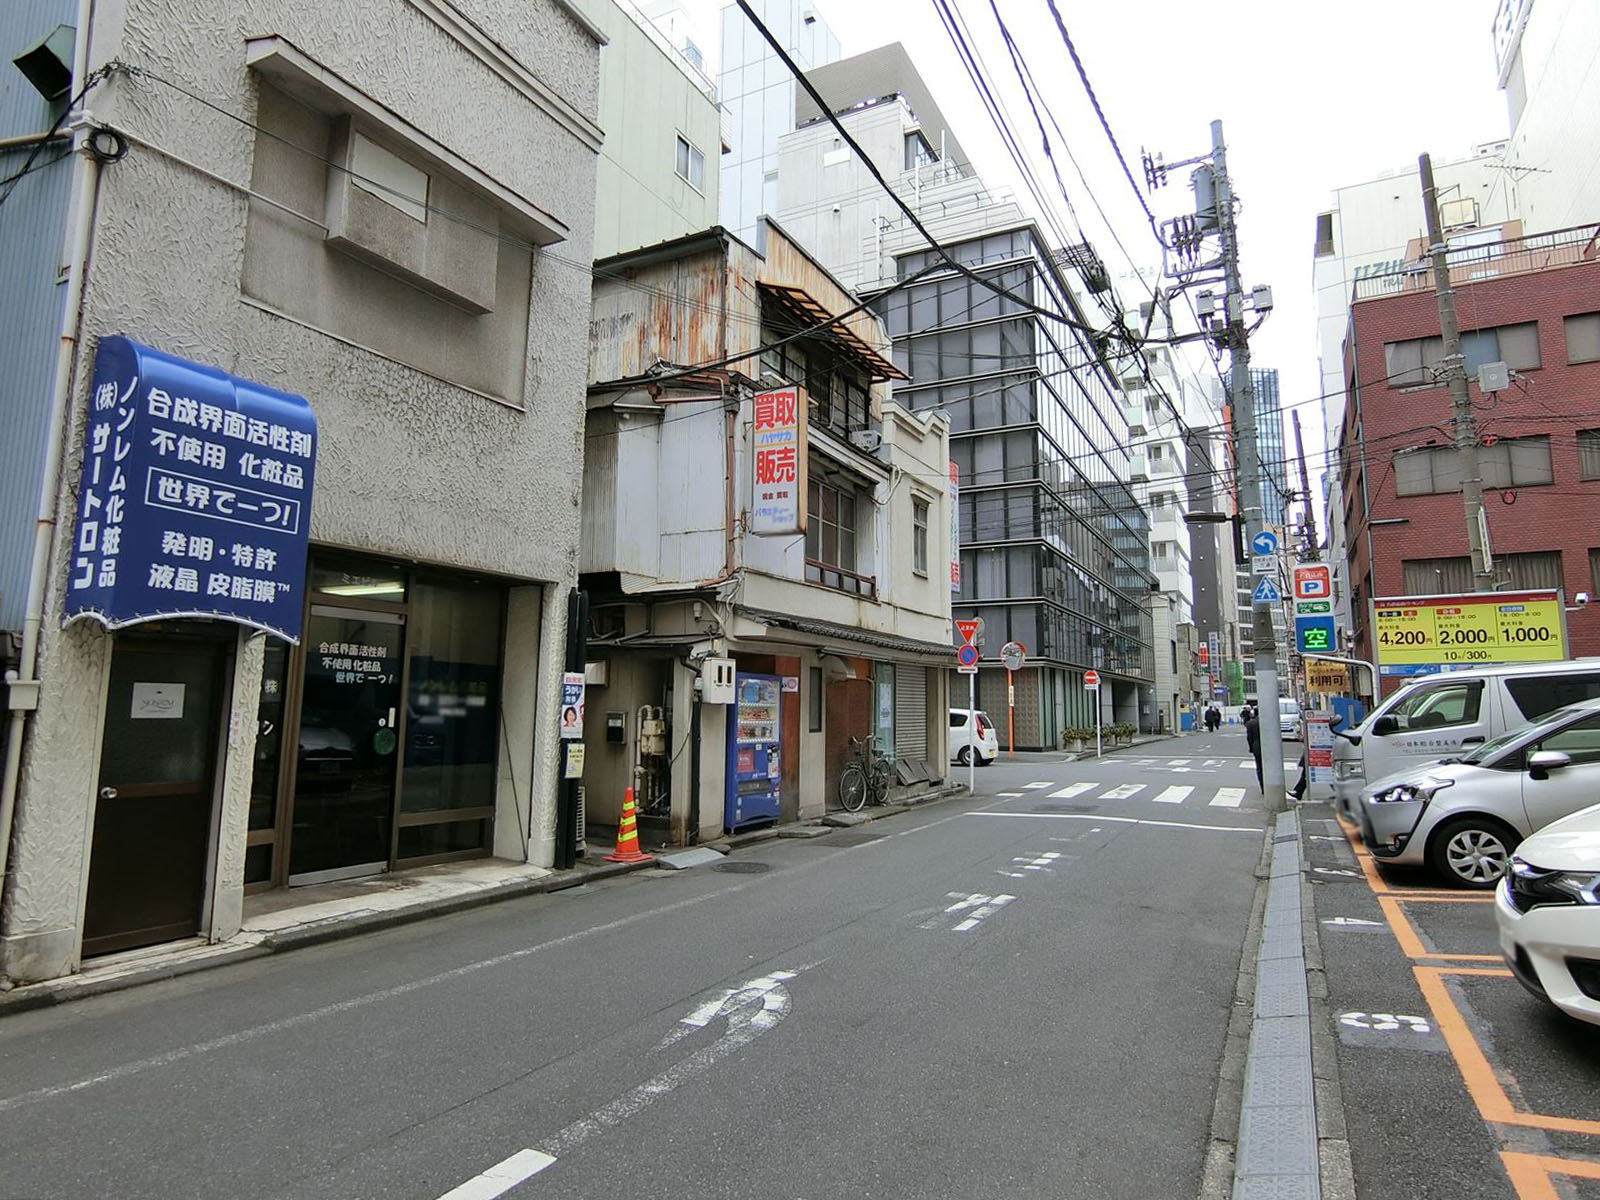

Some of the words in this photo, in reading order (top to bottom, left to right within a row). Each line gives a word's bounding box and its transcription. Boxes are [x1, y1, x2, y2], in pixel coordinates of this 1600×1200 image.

[147, 387, 312, 458] 合成界面活性剤
[755, 392, 796, 430] 買取
[760, 431, 792, 445] ハヤサカ
[151, 428, 226, 470] 不使用
[239, 453, 304, 489] 化粧品
[755, 446, 796, 485] 販売
[98, 376, 138, 587] ノンレム化粧品
[74, 424, 111, 589] サートロン
[162, 530, 277, 571] 発明・特許
[148, 563, 199, 593] 液晶
[1304, 582, 1319, 593] P
[319, 641, 387, 658] 合成界面活性剤
[1304, 628, 1328, 649] 空
[1309, 674, 1344, 687] 利用可
